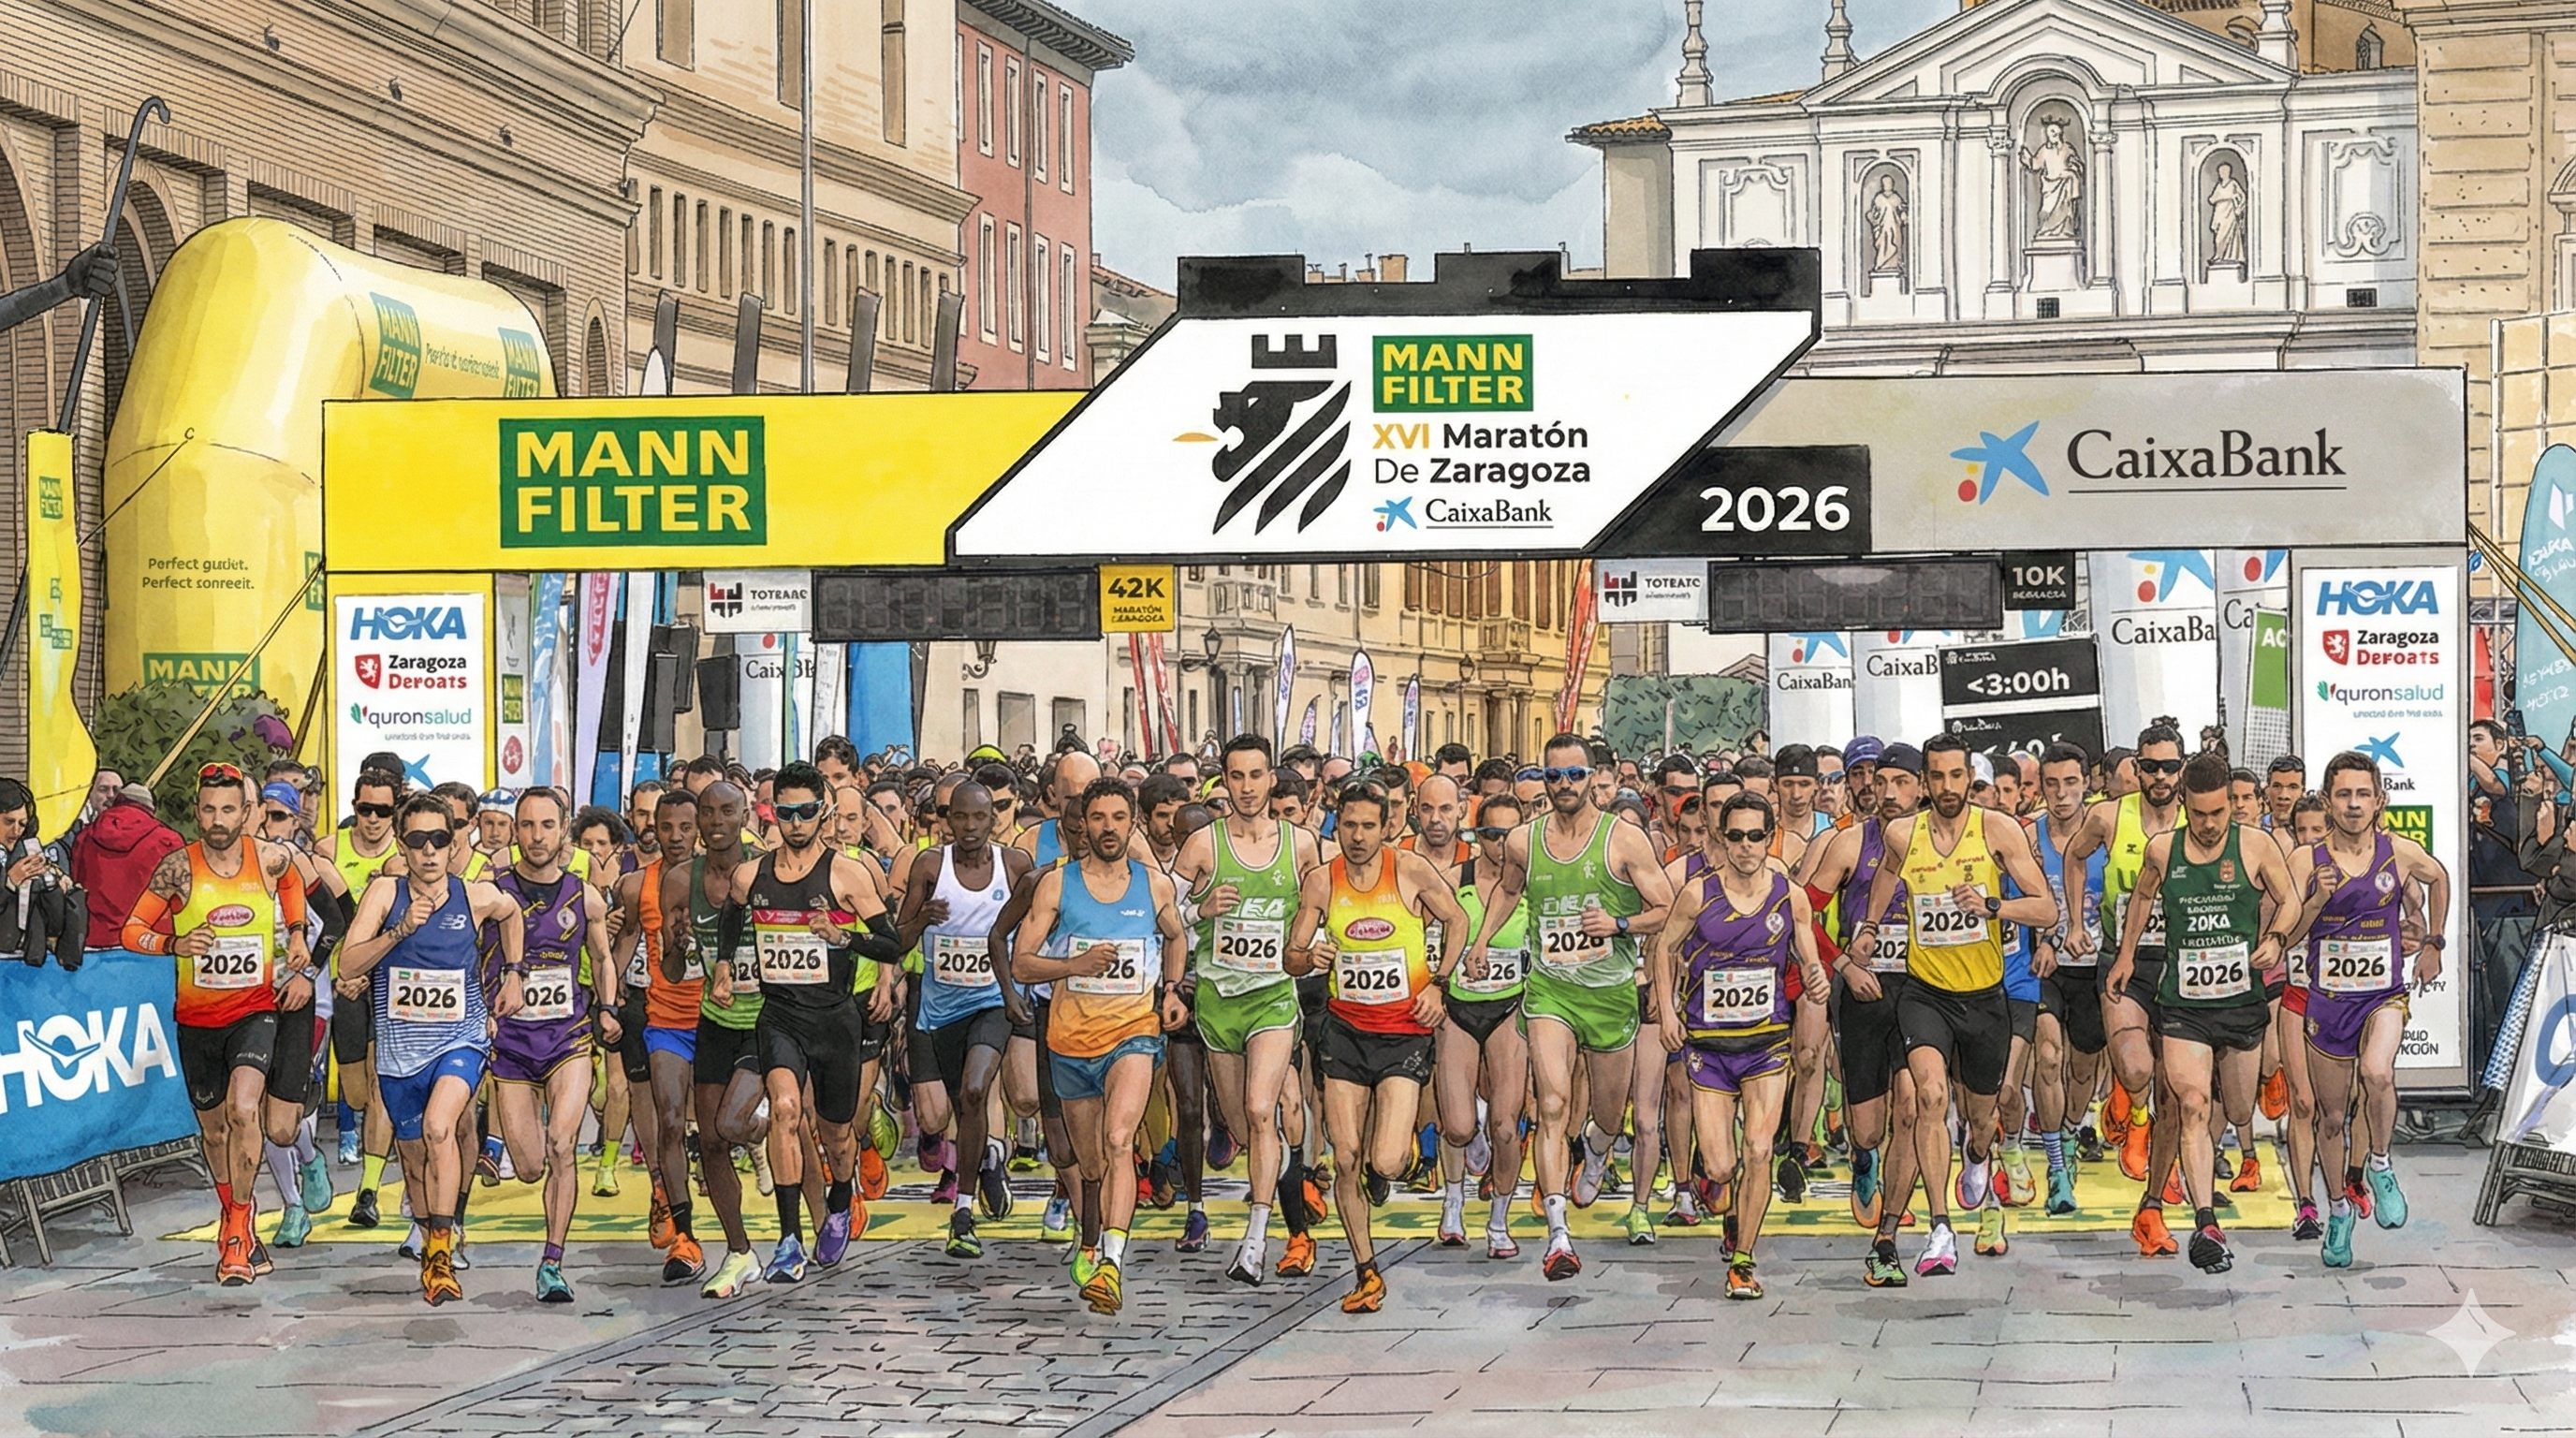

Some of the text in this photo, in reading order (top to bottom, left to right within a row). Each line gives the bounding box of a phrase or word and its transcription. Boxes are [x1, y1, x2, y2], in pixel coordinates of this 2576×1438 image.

[376, 344, 418, 389] FILTER
[1383, 343, 1523, 372] MANN
[1383, 375, 1524, 404] FILTER
[1372, 420, 1588, 449] XVI Maratón
[517, 430, 749, 477] MANN
[2067, 427, 2347, 480] CaixaBank
[1374, 458, 1590, 490] De Zaragoza
[517, 485, 752, 533] FILTER
[1425, 498, 1553, 522] CaixaBank
[1699, 486, 1851, 533] 2026
[142, 575, 193, 589] Perfect
[2012, 565, 2066, 586] 10K
[1107, 577, 1165, 598] 42K
[2316, 580, 2440, 616] HOKA
[350, 606, 467, 640] HOKA
[2111, 615, 2216, 645] CaixaBa
[2357, 630, 2439, 648] Zaragoza
[388, 654, 467, 673] Zaragoza
[1866, 654, 1939, 677] CaixaB
[1777, 671, 1852, 691] CaixaBan
[1967, 666, 2071, 697] <3:00h
[2334, 683, 2444, 706] quronsalud
[368, 709, 472, 728] quronsalud
[2383, 811, 2426, 829] NN
[1922, 910, 1980, 932] 2026
[1220, 935, 1278, 959] 2026
[1870, 939, 1908, 960] 202
[200, 953, 257, 975] 2026
[763, 948, 821, 970] 2026
[938, 952, 990, 973] 2026
[1106, 958, 1135, 979] 26
[2327, 956, 2386, 978] 2026
[1342, 968, 1401, 990] 2026
[1490, 963, 1515, 980] 26
[2186, 961, 2244, 987] 2026
[397, 985, 457, 1008] 2026
[525, 984, 567, 1007] 026
[1712, 984, 1769, 1008] 2026
[0, 1002, 178, 1114] HOKA
